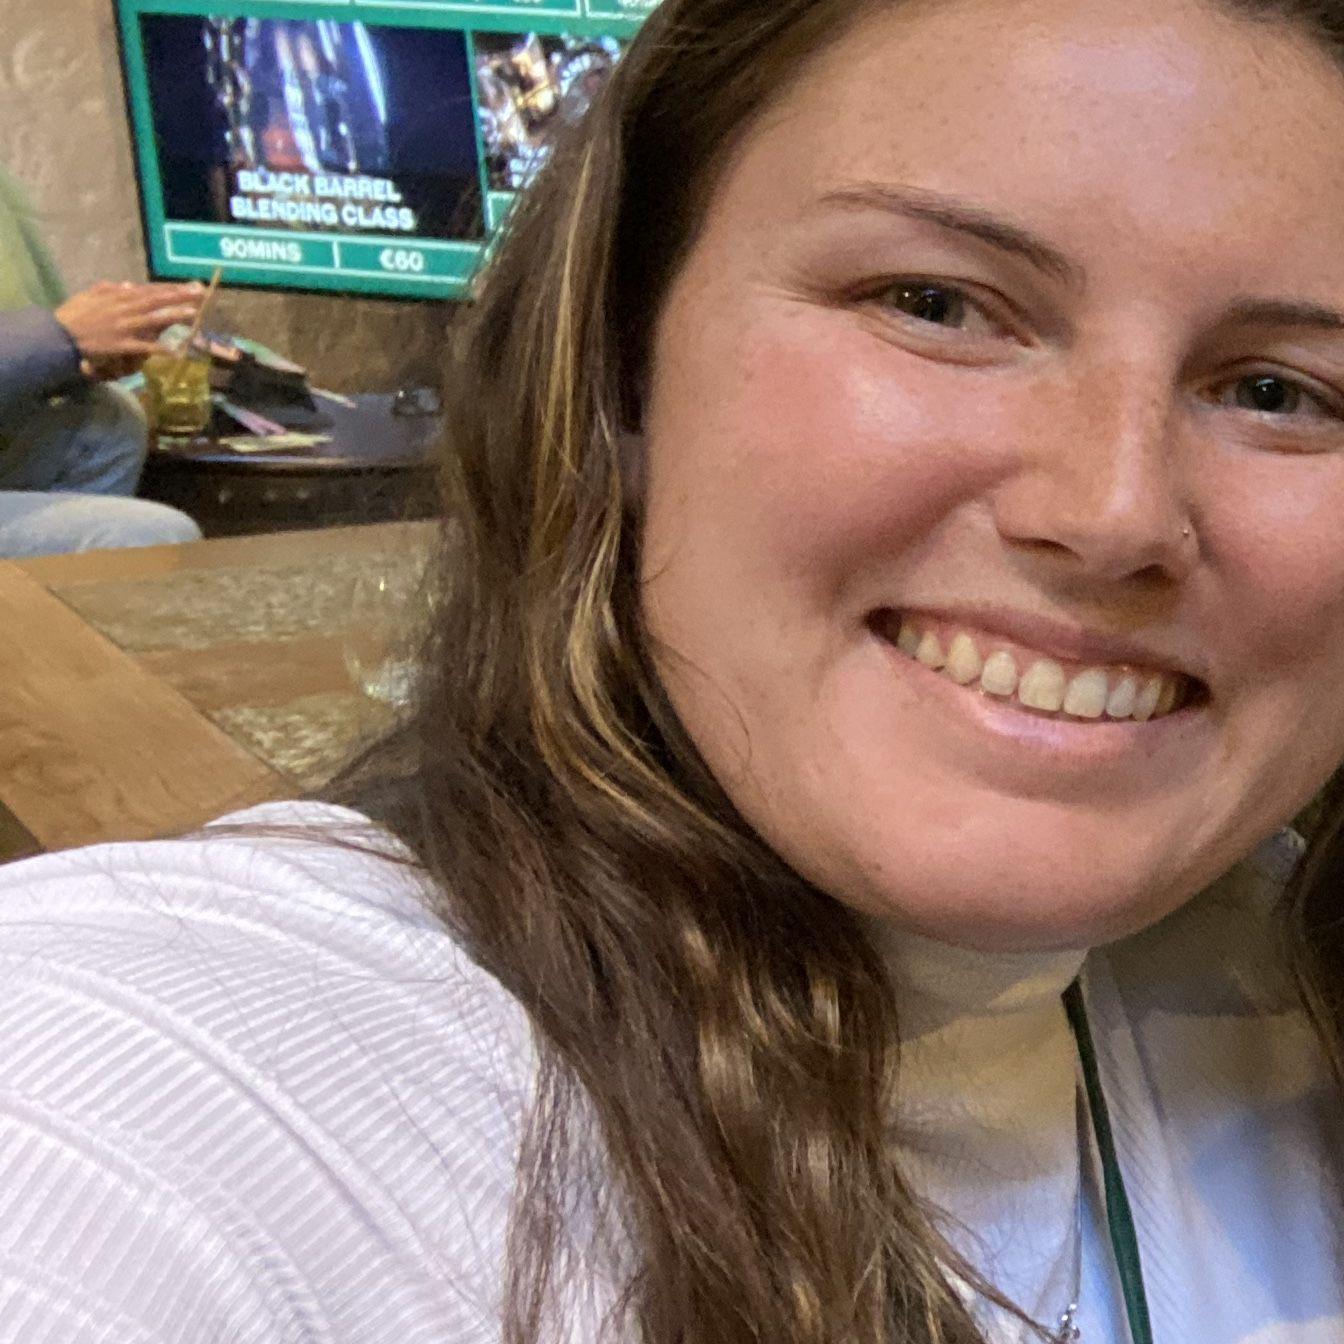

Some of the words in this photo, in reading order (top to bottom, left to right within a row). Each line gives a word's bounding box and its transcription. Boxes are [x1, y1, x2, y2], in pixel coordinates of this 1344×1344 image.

[236, 169, 312, 195] BLACK
[314, 173, 403, 203] BARREL
[229, 195, 338, 226] BLENDING
[340, 205, 418, 232] CLASS
[219, 236, 304, 263] 90MINS
